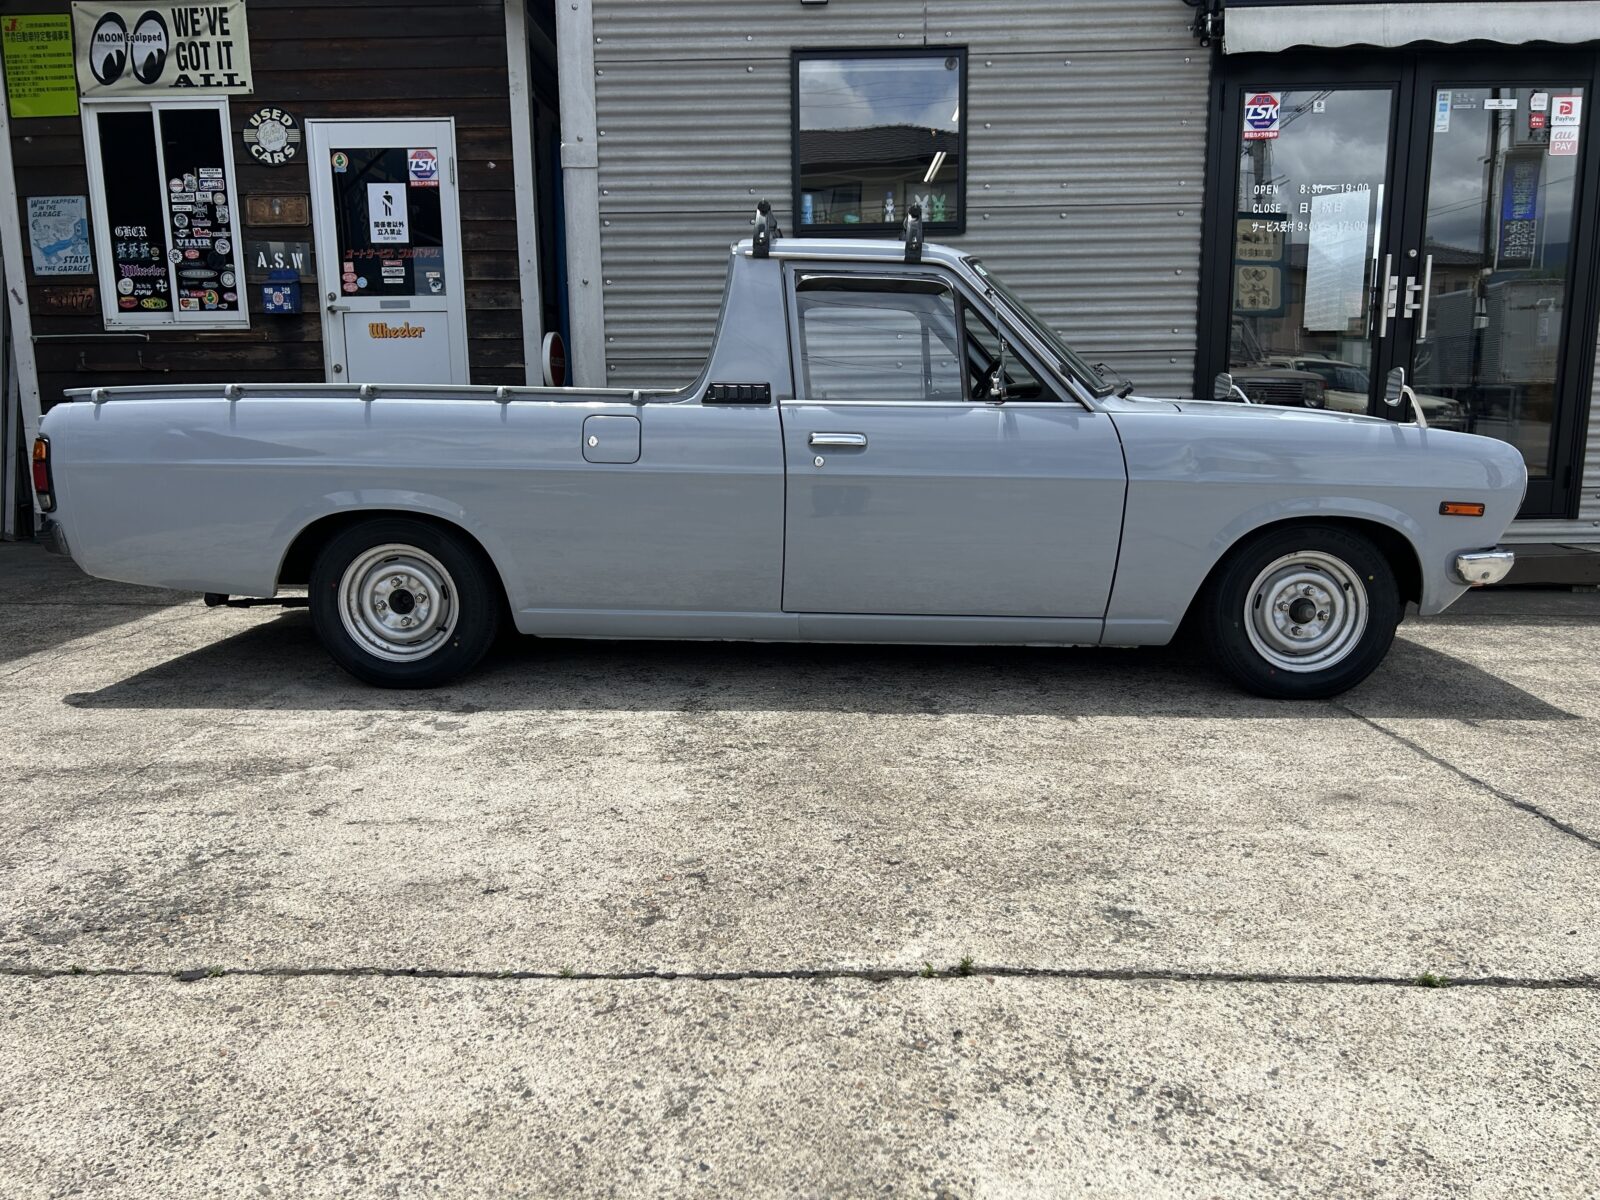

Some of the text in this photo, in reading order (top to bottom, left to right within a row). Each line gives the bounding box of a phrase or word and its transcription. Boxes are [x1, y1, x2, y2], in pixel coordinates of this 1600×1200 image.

[171, 7, 230, 37] WE'VE
[97, 32, 162, 44] MOON Equipped
[176, 41, 233, 71] GOT IT
[169, 73, 246, 88] ALL
[249, 108, 293, 126] USED
[1245, 104, 1279, 119] TSK
[1555, 131, 1574, 140] au
[1554, 143, 1572, 151] PAY
[251, 145, 295, 163] CARS
[408, 159, 437, 171] TSK
[1253, 184, 1279, 194] OPEN
[30, 199, 50, 208] WHAT
[1252, 203, 1281, 213] CLOSE
[373, 221, 405, 229] 関係者以外
[1251, 221, 1295, 233] サービス受付
[176, 239, 211, 247] VIAIR
[63, 255, 90, 264] STAYS
[257, 251, 303, 269] A.S.W
[58, 263, 91, 272] GARAGE!
[368, 321, 426, 339] Wheeler
